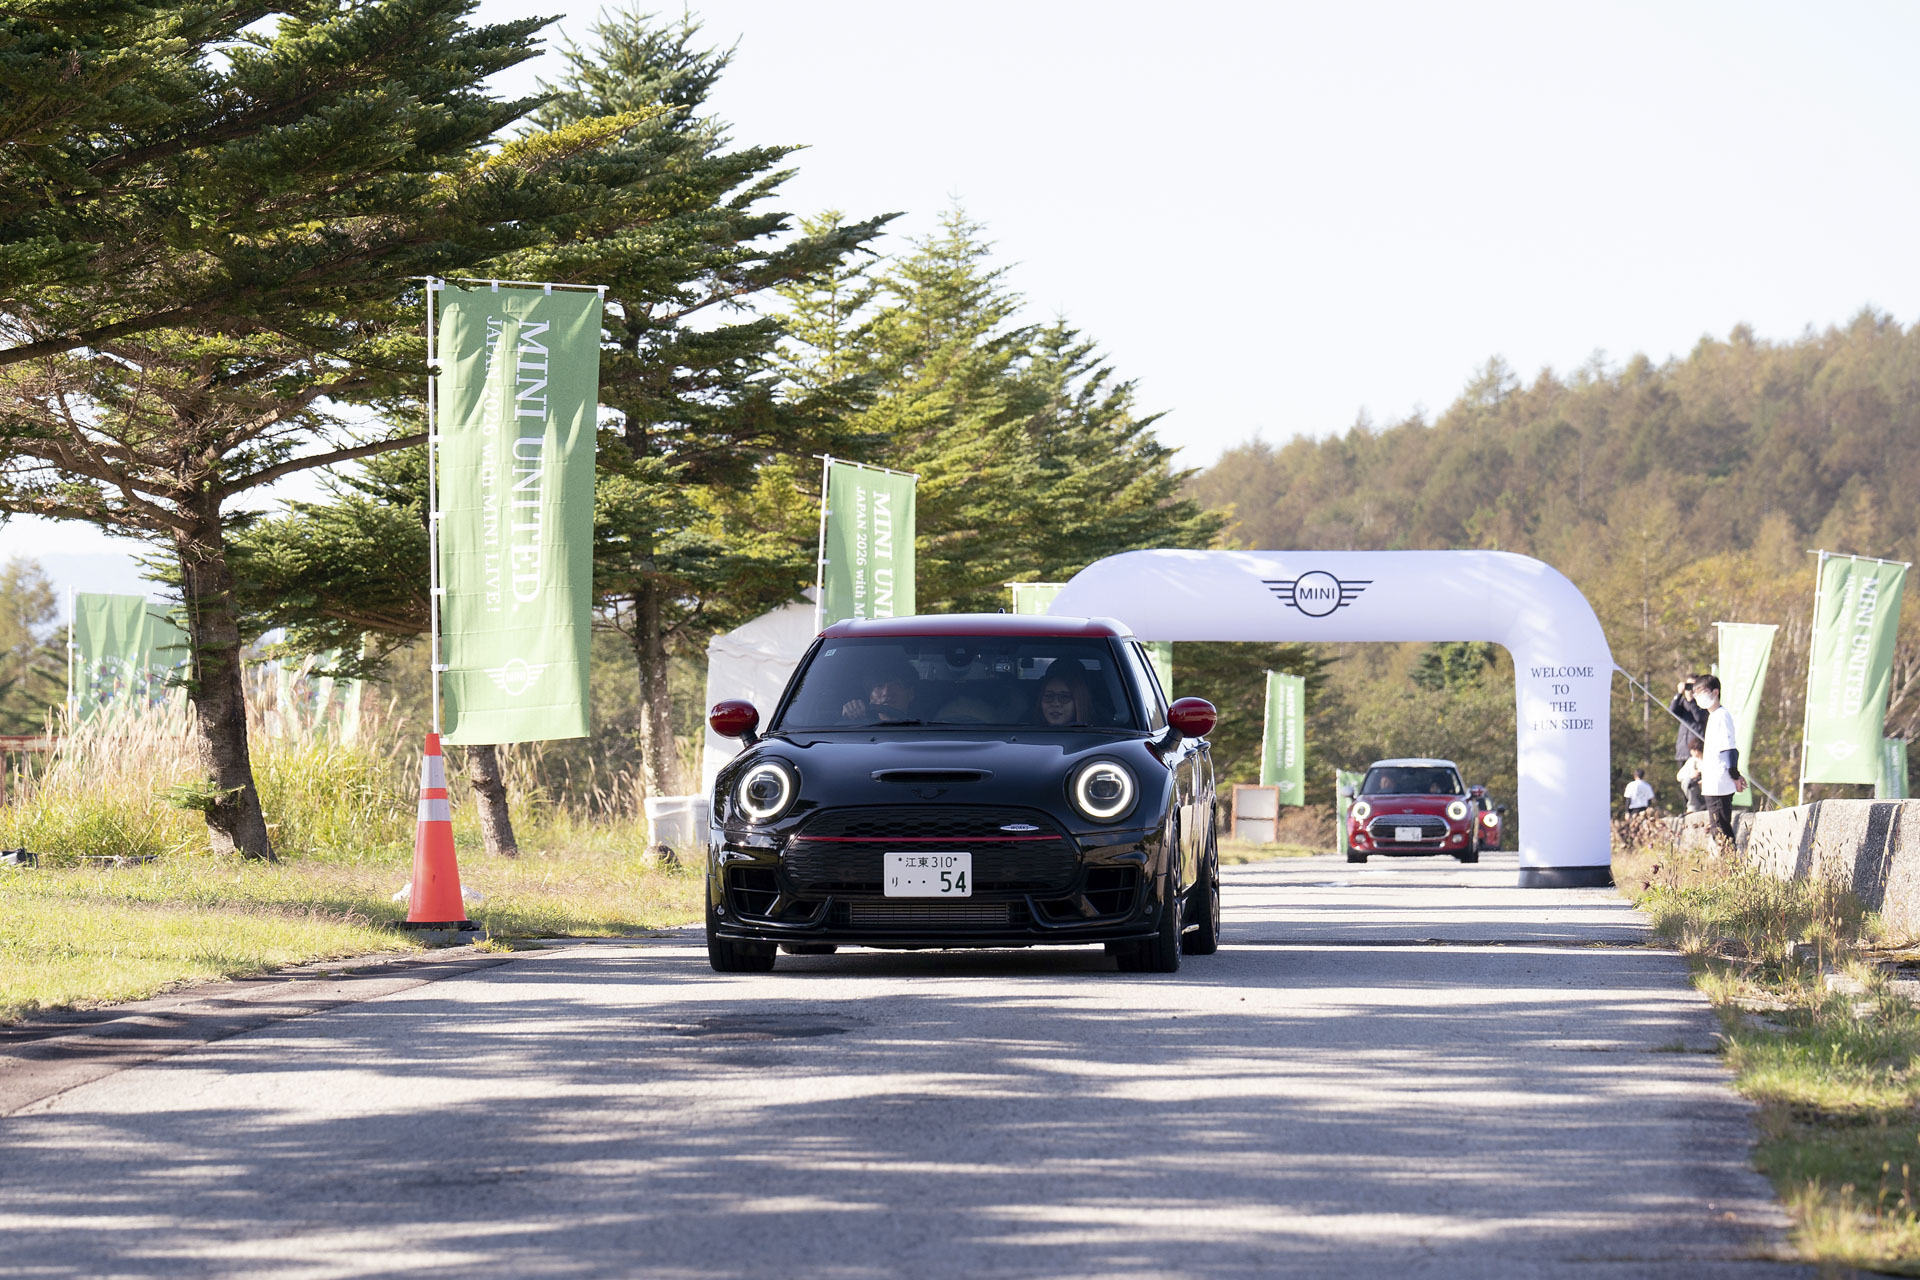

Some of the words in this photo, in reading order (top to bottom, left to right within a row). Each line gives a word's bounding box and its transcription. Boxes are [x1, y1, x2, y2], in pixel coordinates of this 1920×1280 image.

[484, 315, 503, 380] JAPAN
[514, 318, 550, 422] MINI
[482, 385, 499, 436] 2026
[481, 442, 498, 487] with
[482, 494, 499, 547] MINI
[511, 435, 545, 612] UNITED.
[856, 486, 867, 530] JAPAN
[873, 490, 893, 560] MINI
[856, 533, 868, 566] 2026
[484, 553, 501, 613] LIVE!
[855, 569, 868, 599] with
[1299, 587, 1336, 601] MINI
[1855, 575, 1880, 627] MINI
[1530, 666, 1594, 678] WELCOME
[1552, 684, 1570, 695] TO
[1549, 701, 1577, 712] THE
[1561, 719, 1593, 730] SIDE!
